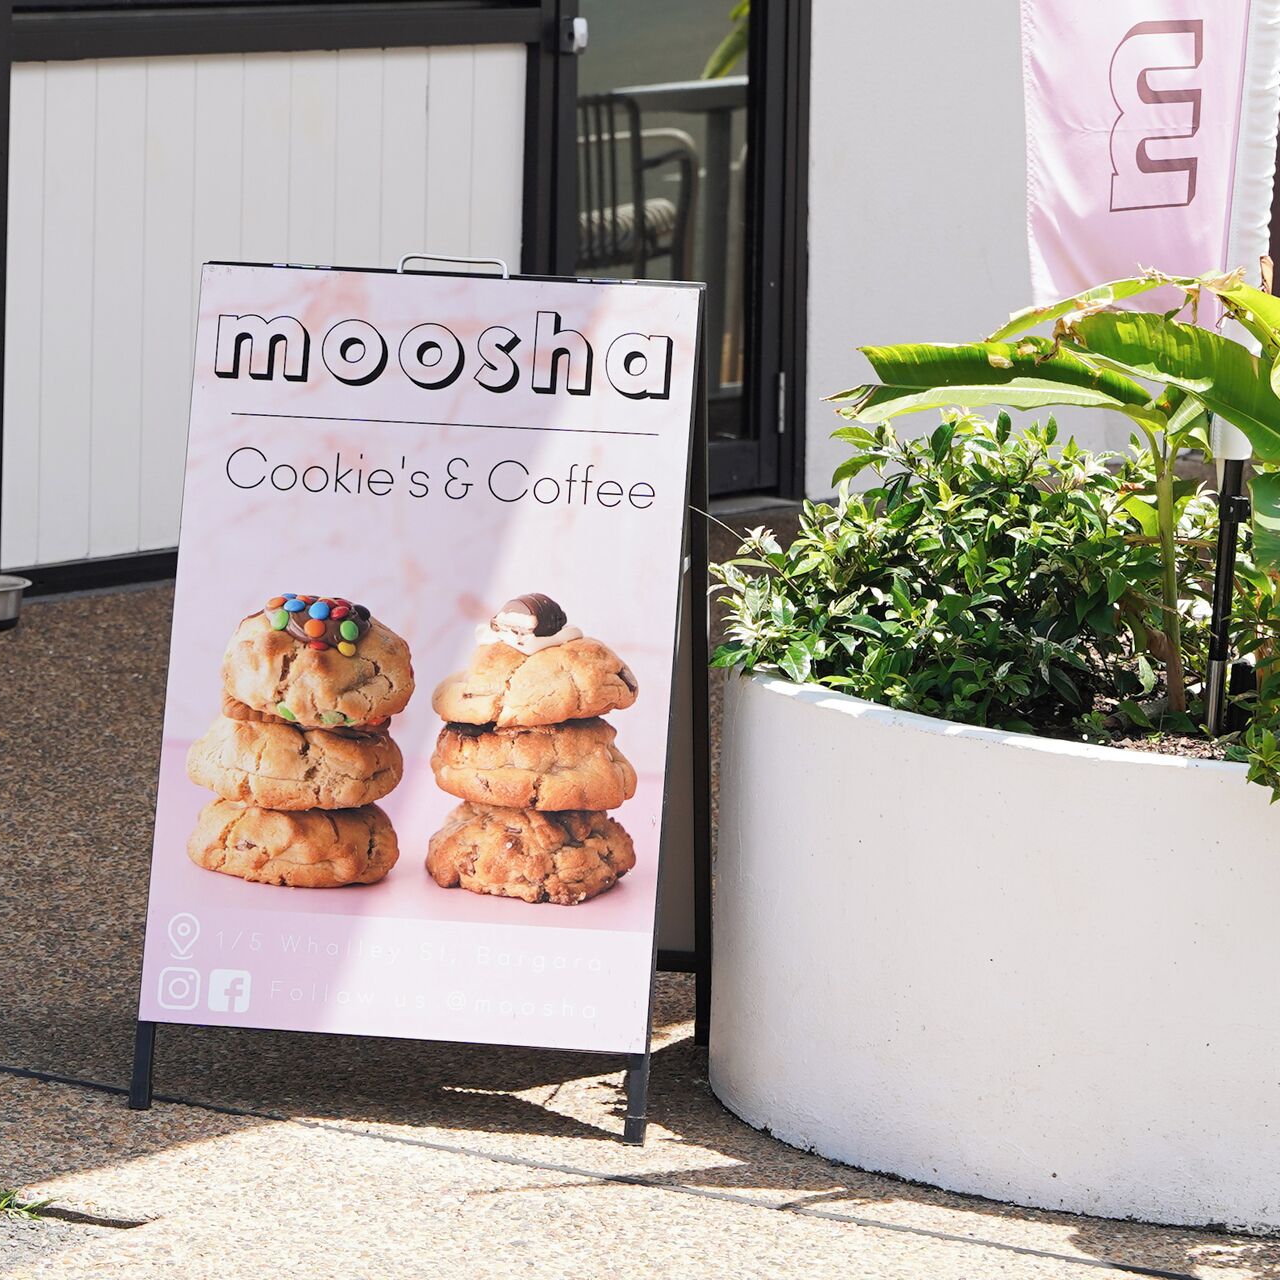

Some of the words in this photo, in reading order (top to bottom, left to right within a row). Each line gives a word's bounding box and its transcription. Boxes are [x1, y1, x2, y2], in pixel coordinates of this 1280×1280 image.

[214, 311, 674, 400] moosha
[225, 447, 430, 498] Cookie's
[444, 457, 474, 500] &
[488, 460, 656, 509] Coffee
[215, 931, 263, 952] 1/5
[281, 934, 401, 966] Whalley
[477, 946, 602, 972] Bargara
[271, 980, 376, 1004] Follow
[396, 993, 425, 1009] us
[447, 990, 596, 1021] @moosha
